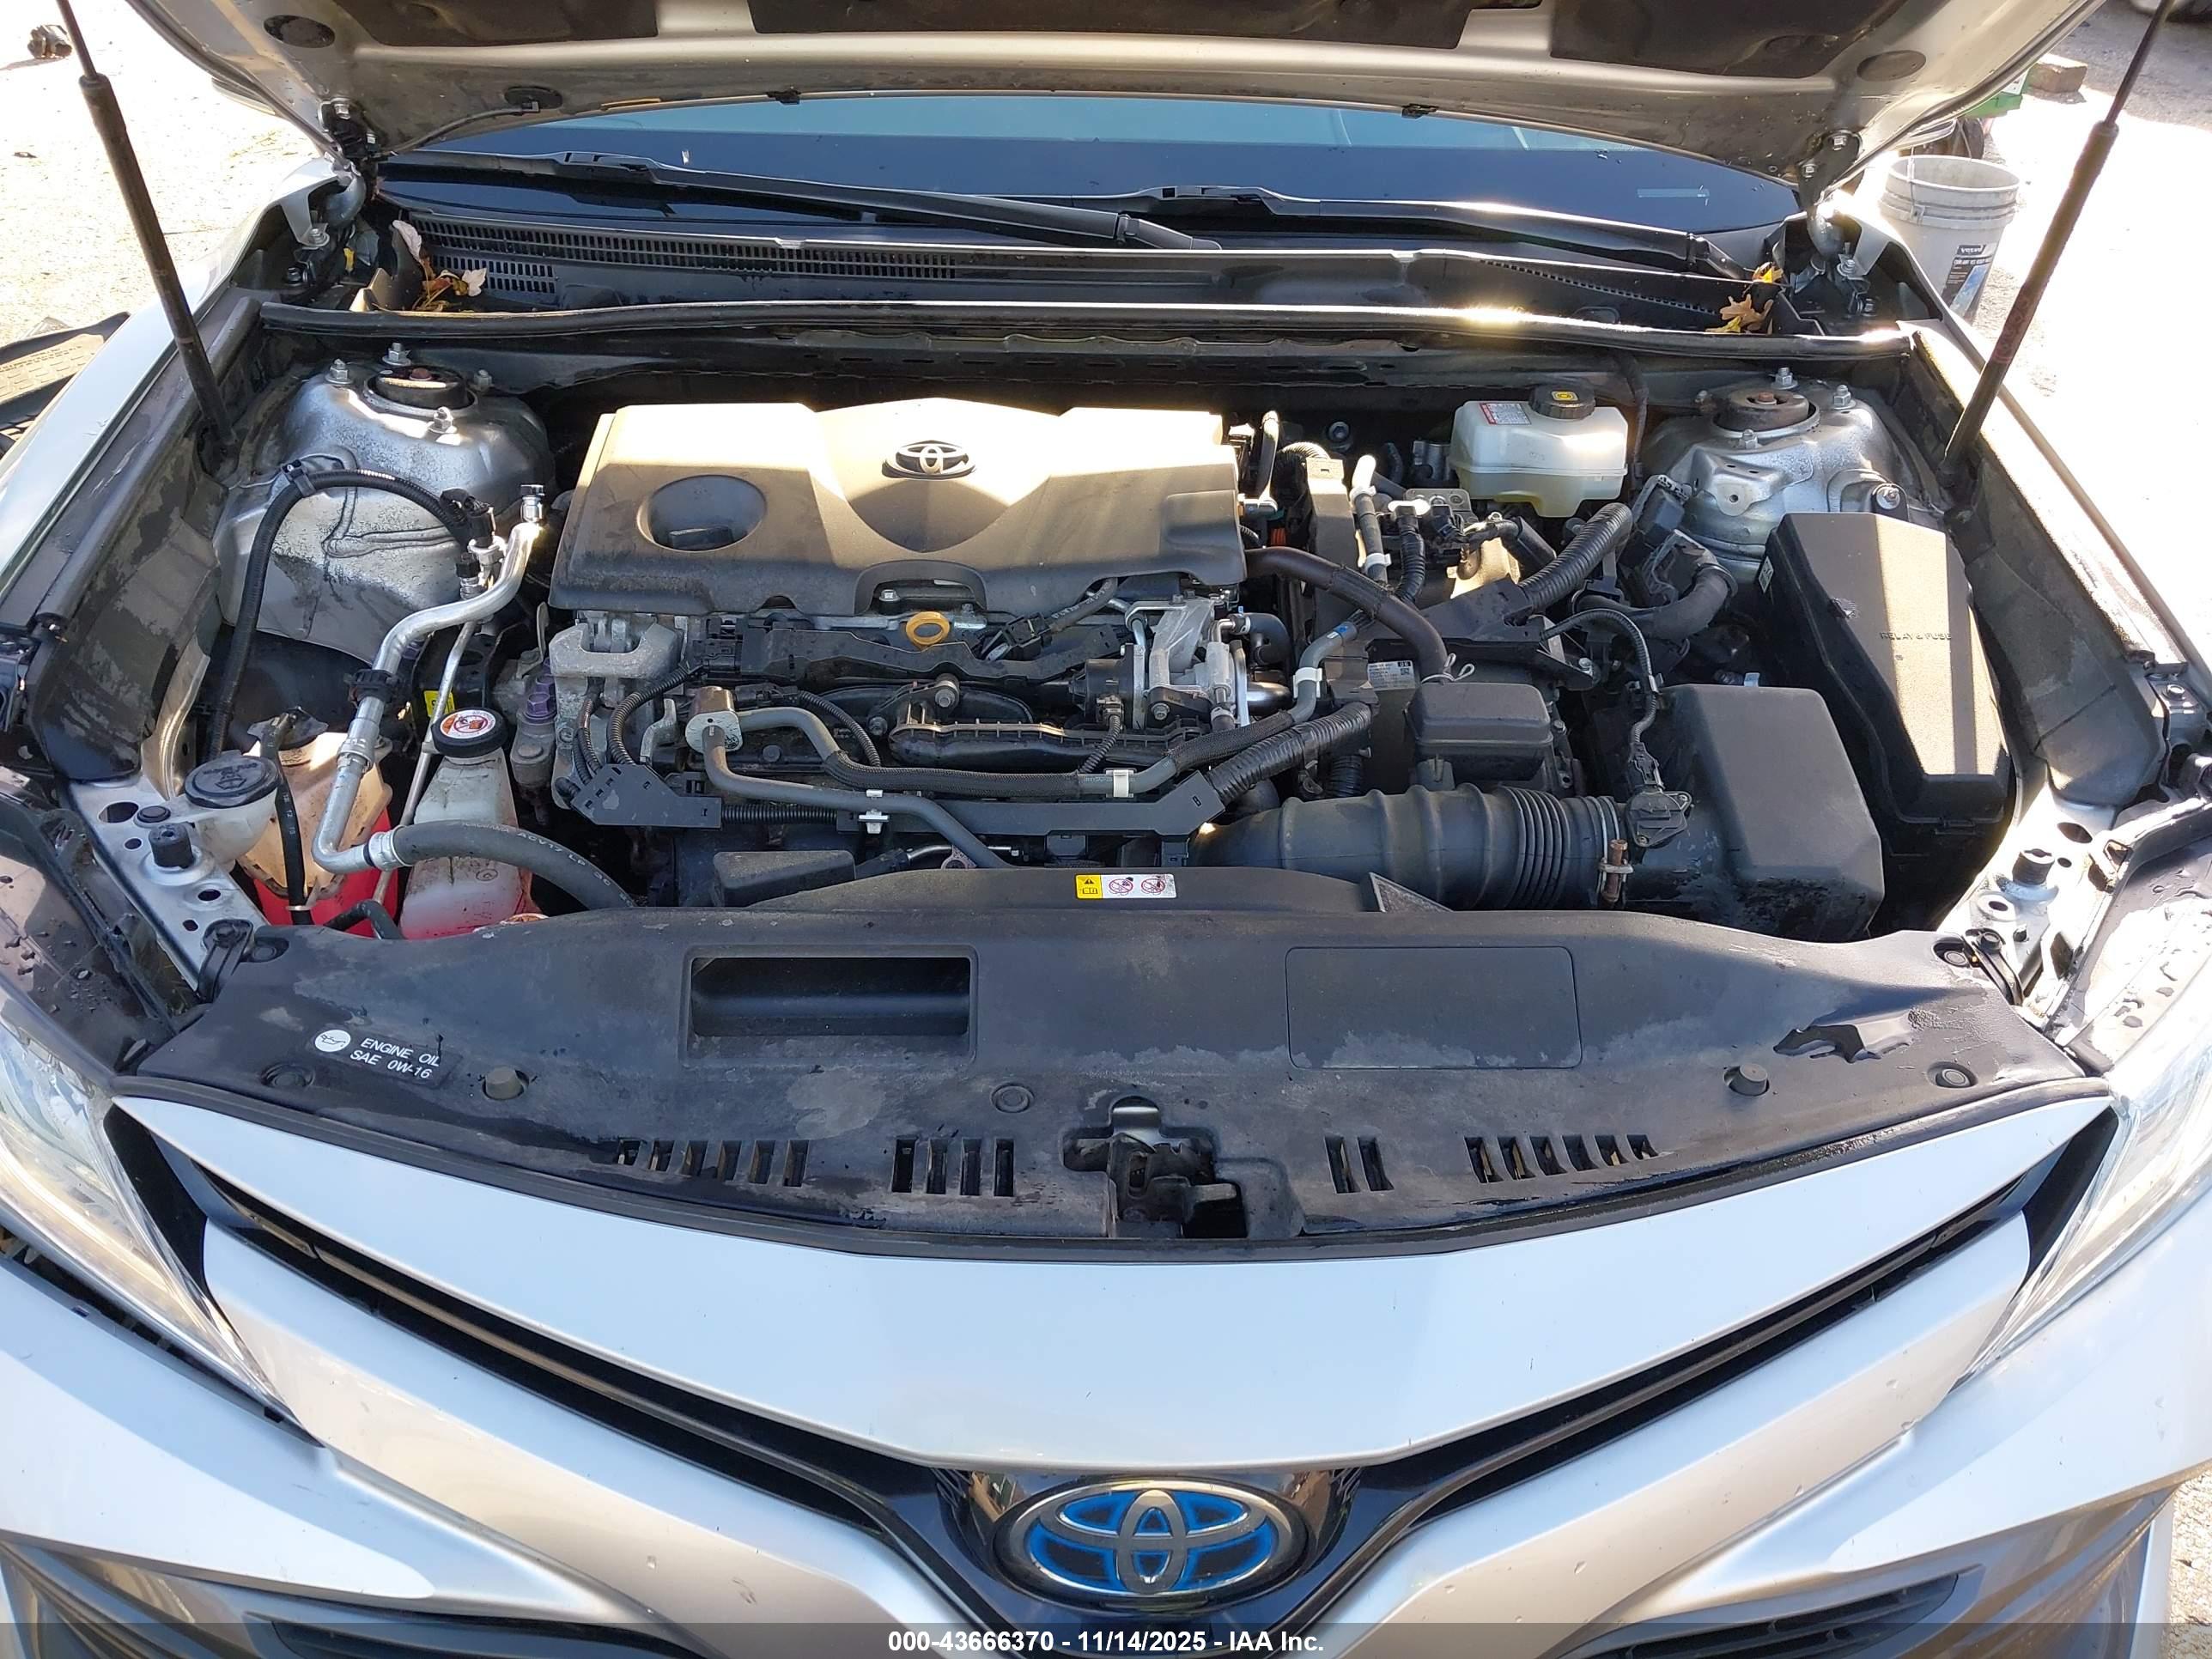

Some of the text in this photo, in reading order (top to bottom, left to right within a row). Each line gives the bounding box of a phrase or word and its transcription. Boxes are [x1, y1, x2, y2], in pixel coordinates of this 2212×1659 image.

[1879, 632, 1913, 641] RELAY
[1926, 632, 1952, 641] FUSE
[349, 1049, 432, 1079] SAE 0W-16
[360, 1037, 440, 1066] ENGINE OIL
